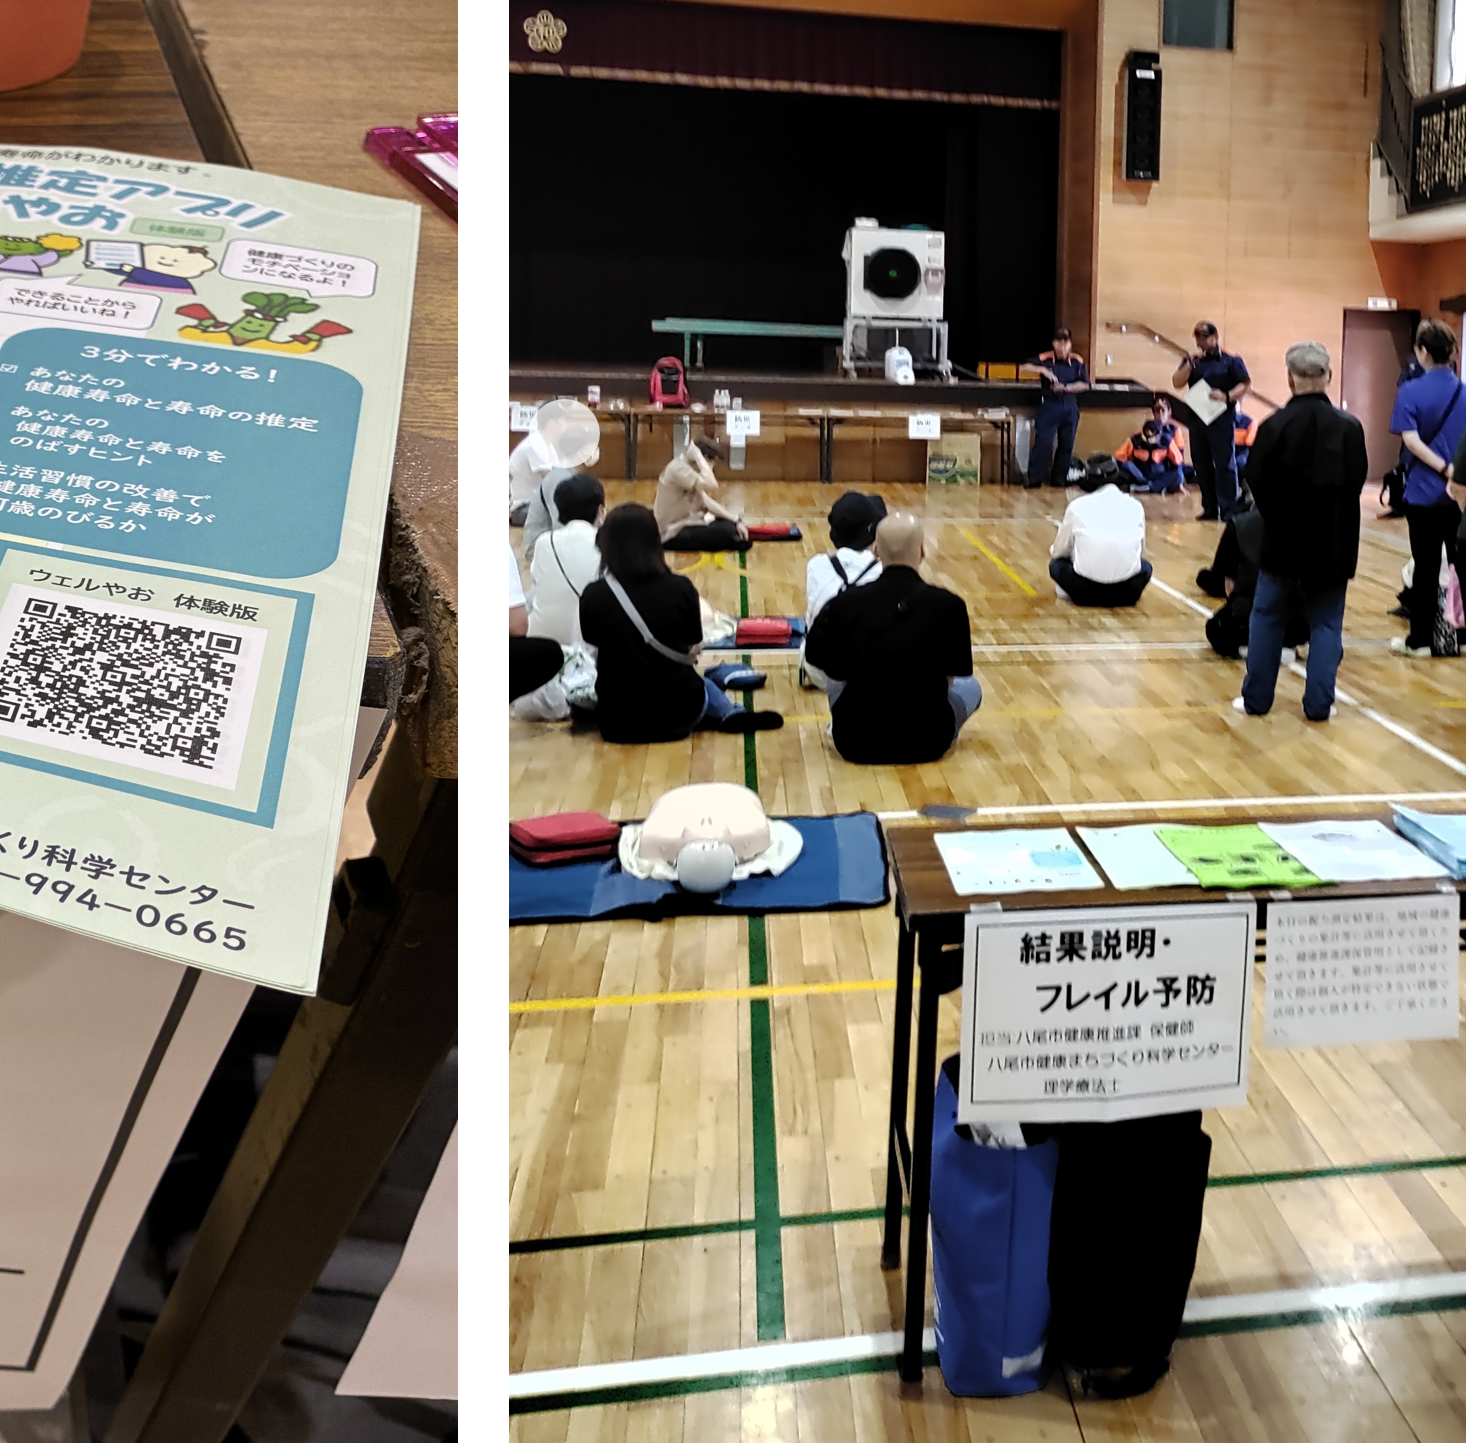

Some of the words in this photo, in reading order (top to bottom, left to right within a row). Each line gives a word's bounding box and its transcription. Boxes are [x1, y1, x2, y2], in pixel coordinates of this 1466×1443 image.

[148, 221, 208, 238] 体験版
[246, 247, 355, 272] 健康づくりの
[7, 296, 131, 320] やればいいね！
[15, 287, 137, 310] できることから
[79, 345, 279, 384] 3分でわかる！
[29, 366, 127, 389] あなたの
[10, 405, 109, 429] あなたの
[24, 379, 320, 434] 健康寿命と寿命の推定
[9, 433, 153, 468] のばすヒント
[15, 420, 227, 465] 健康寿命と寿命を
[28, 567, 155, 603] ウェルやお
[173, 591, 260, 623] 体験版
[1035, 973, 1217, 1014] フレイル予防
[1150, 1019, 1195, 1037] 保健師
[987, 1042, 1235, 1073] 八尾市健康まちづくり科学センター
[1043, 1077, 1120, 1095] 理学療法士
